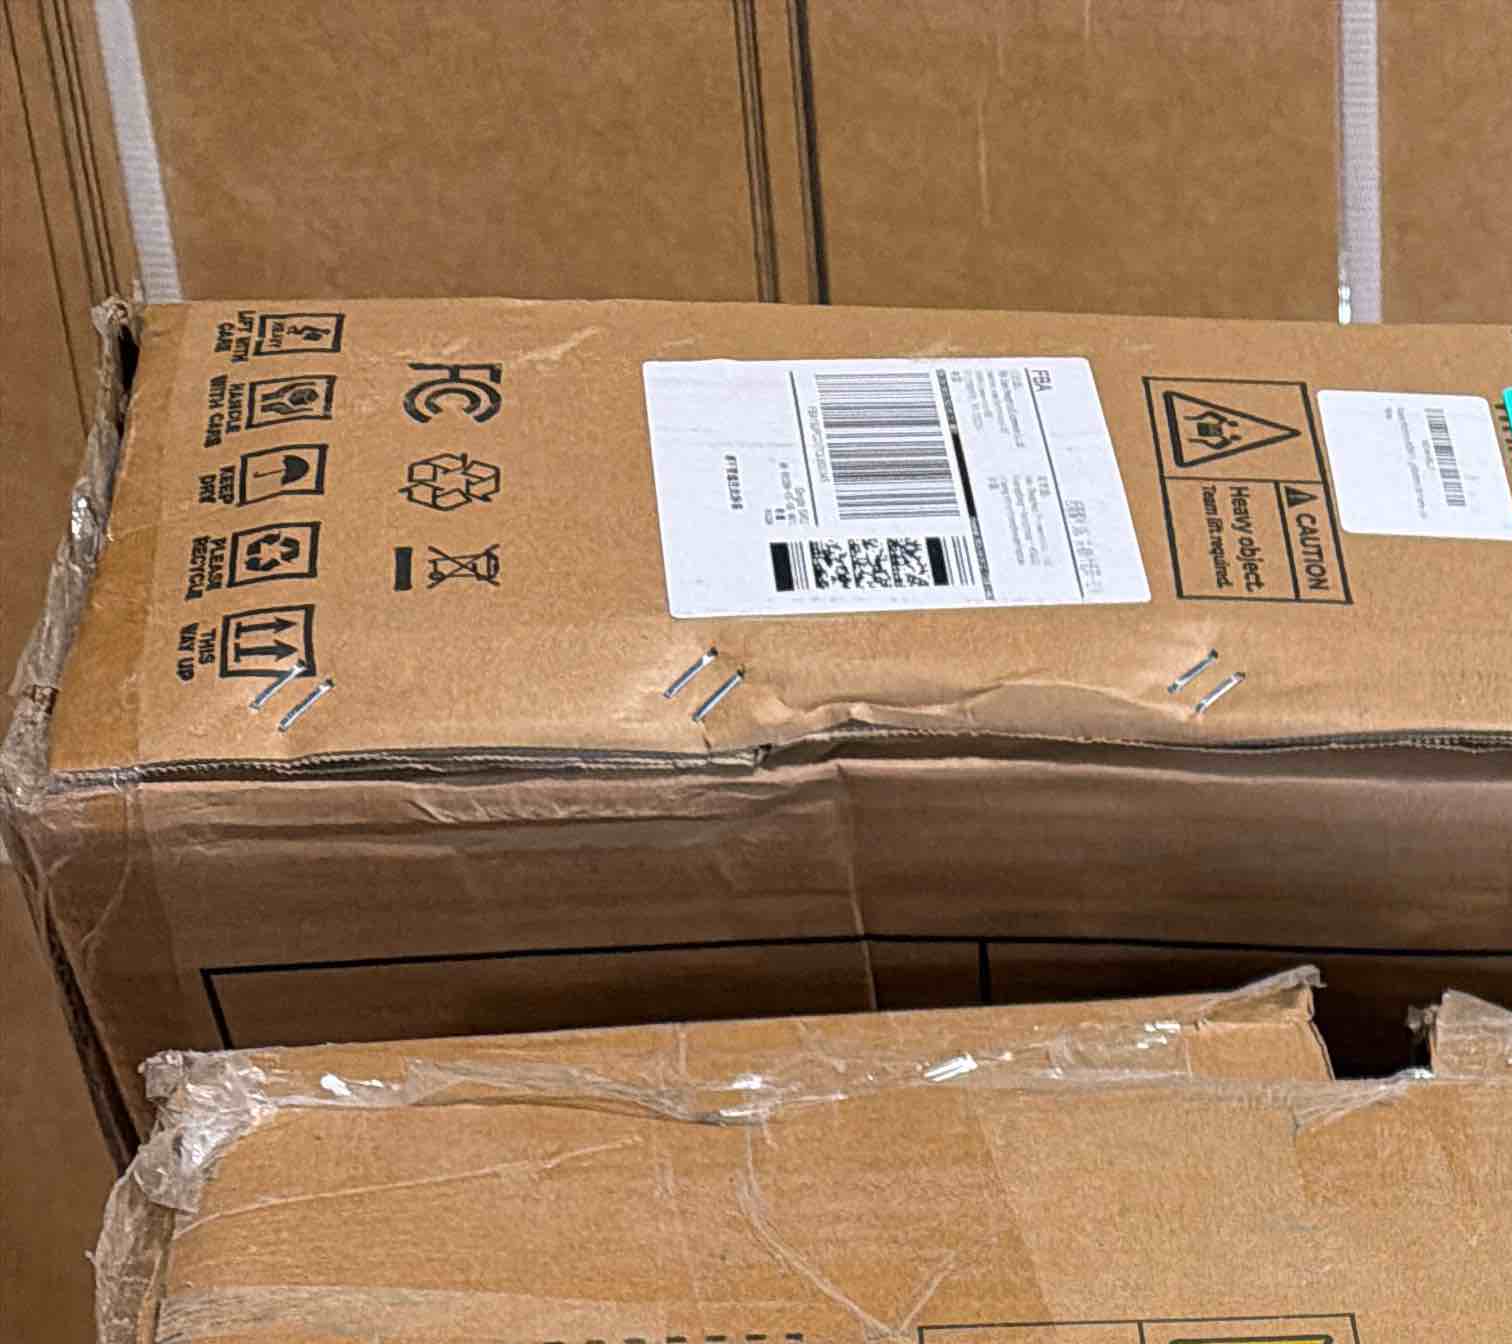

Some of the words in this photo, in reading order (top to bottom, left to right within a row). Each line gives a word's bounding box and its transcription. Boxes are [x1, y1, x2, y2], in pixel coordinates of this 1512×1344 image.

[214, 321, 235, 353] CARE
[236, 310, 256, 333] LIFT
[230, 337, 251, 363] WITH
[208, 374, 228, 410] WITH
[225, 383, 246, 434] HANDLE
[203, 413, 225, 449] CARE
[197, 473, 216, 504] DRY
[218, 465, 236, 505] KEEP
[1201, 485, 1219, 516] Team
[1228, 486, 1255, 536] Heavy
[184, 535, 209, 601] RECYCLE
[205, 536, 227, 592] PLEASE
[1296, 512, 1331, 592] CAUTION
[177, 622, 200, 652] WAY
[198, 627, 217, 665] THIS
[177, 656, 195, 682] UP
